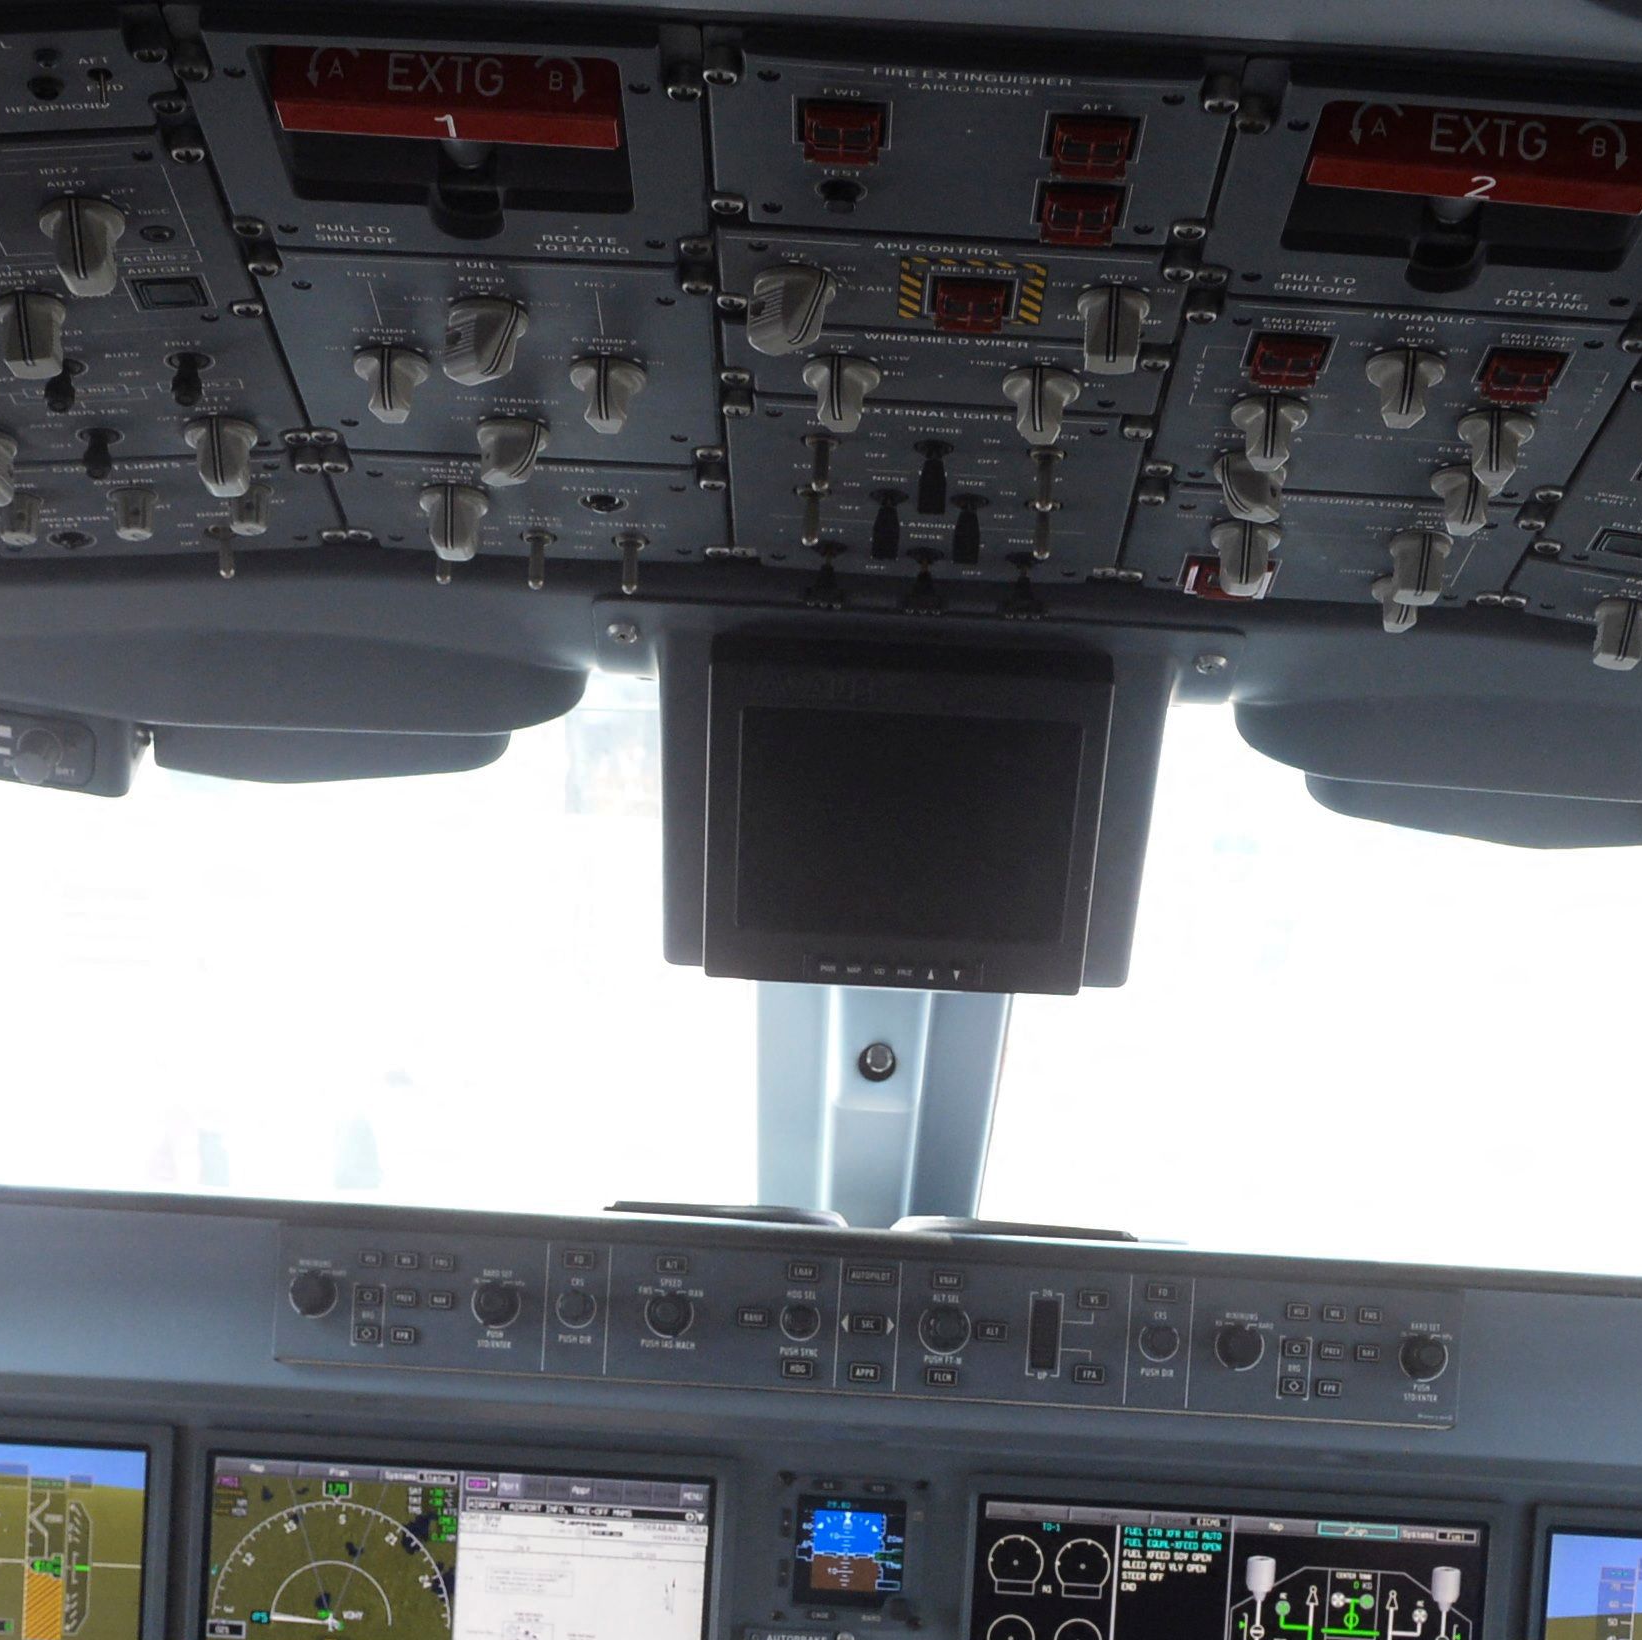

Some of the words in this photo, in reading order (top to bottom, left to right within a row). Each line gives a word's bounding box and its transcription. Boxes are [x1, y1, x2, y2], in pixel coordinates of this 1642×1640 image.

[328, 58, 344, 79] A
[387, 53, 504, 96] EXTG
[550, 71, 563, 91] B
[872, 67, 915, 80] FIRE
[922, 70, 1073, 88] EXTINGUISHER
[823, 88, 861, 97] FWD
[907, 82, 970, 94] CARGO
[974, 86, 1035, 97] SMOKE
[1082, 102, 1114, 112] AFT
[434, 114, 457, 138] 1
[1371, 118, 1388, 137] A
[1430, 114, 1547, 160] EXTG
[1592, 137, 1606, 157] B
[822, 168, 862, 178] TEST
[1463, 175, 1497, 200] 2
[315, 223, 360, 235] PULL
[367, 225, 390, 235] TO
[315, 233, 397, 245] SHUTOFF
[543, 234, 618, 246] ROTATE
[533, 243, 559, 252] TO
[562, 244, 630, 255] EXTING
[874, 242, 912, 253] APU
[916, 243, 1003, 257] CONTROL
[456, 260, 500, 271] FUEL
[931, 265, 972, 275] EMER
[977, 266, 1018, 276] STOP
[1281, 272, 1326, 284] PULL
[1332, 275, 1357, 286] TO
[1273, 281, 1357, 297] SHUTOFF
[1506, 289, 1584, 303] ROTATE
[1494, 297, 1519, 308] TO
[1521, 298, 1589, 313] EXTING
[1373, 311, 1478, 327] HYDRAULIC
[865, 332, 970, 346] WINDSHIELD
[974, 338, 1029, 349] WIPER
[953, 410, 1013, 422] LIGHTS
[908, 425, 963, 435] STROBE
